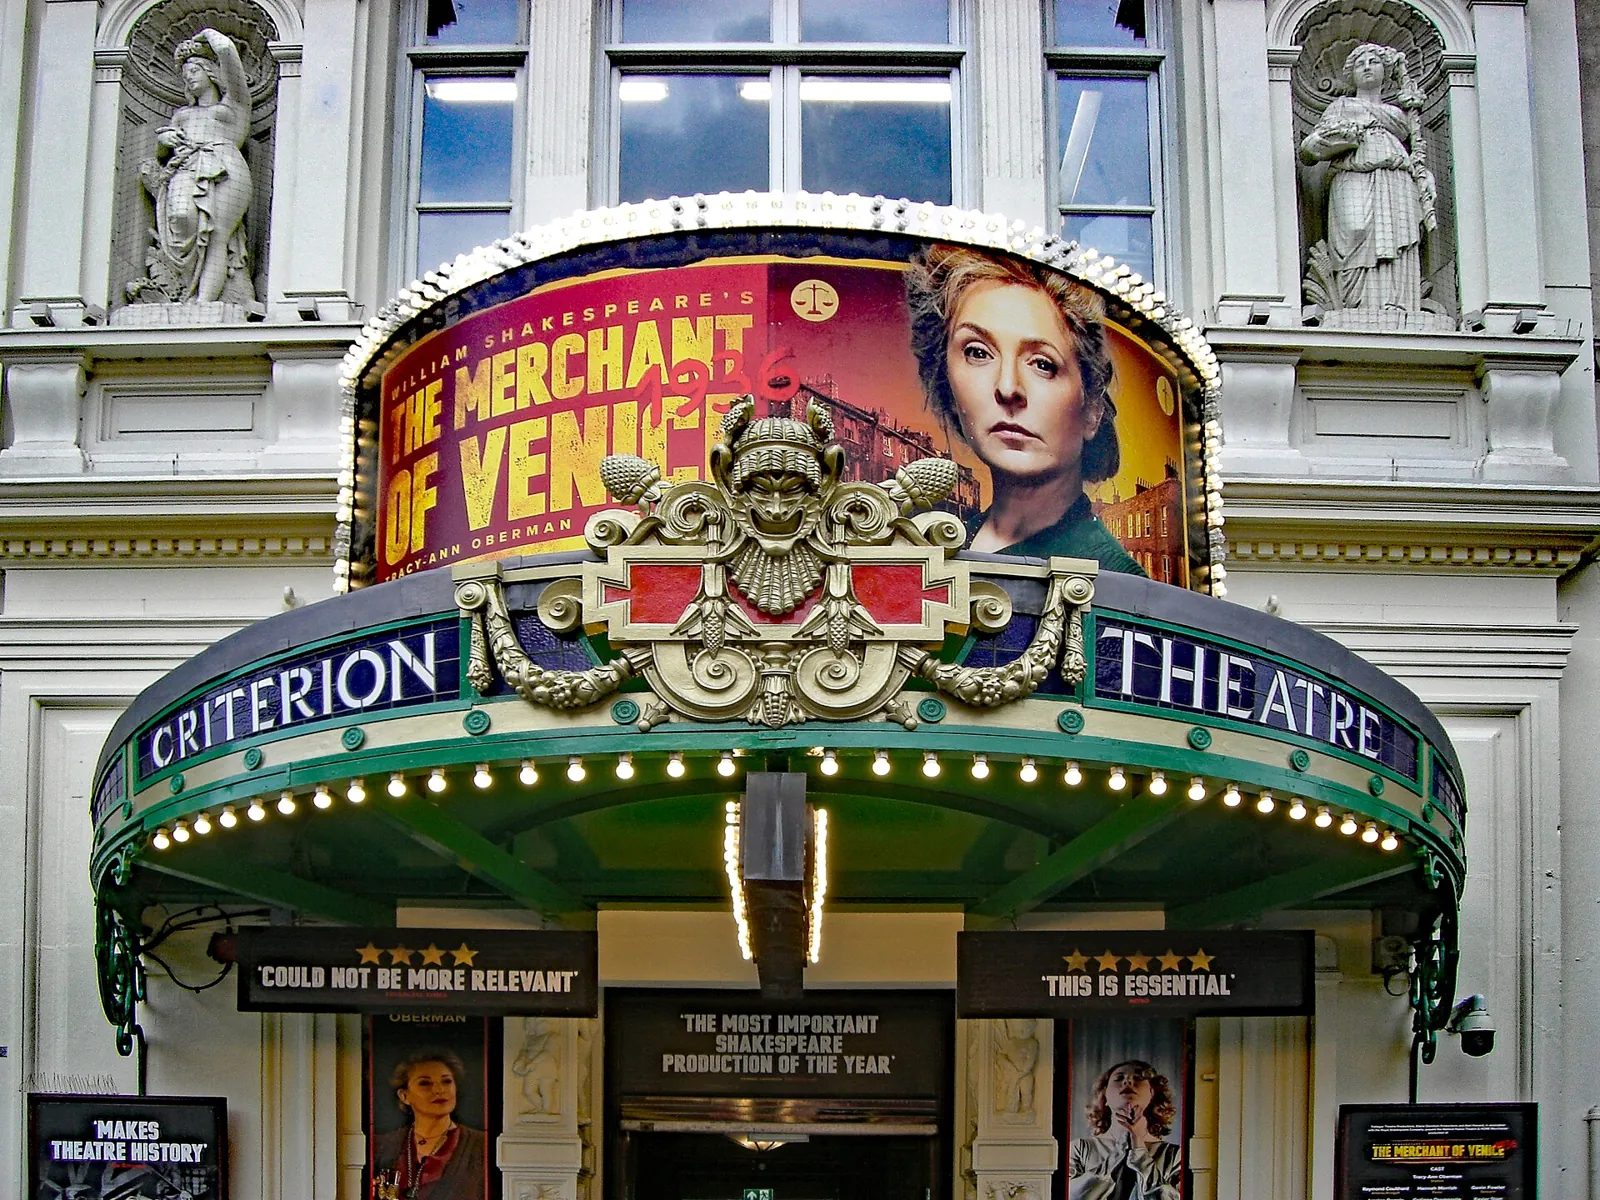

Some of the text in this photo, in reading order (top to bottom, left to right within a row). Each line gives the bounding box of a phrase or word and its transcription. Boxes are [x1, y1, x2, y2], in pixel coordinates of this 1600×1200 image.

[391, 290, 755, 399] WILLIAM SHAKESPEARE'S
[391, 314, 753, 464] THE MERCHANT
[634, 344, 802, 428] 1936
[385, 452, 438, 565] OF
[471, 518, 572, 550] OBERMAN
[151, 632, 436, 769] CRITERION
[1101, 627, 1382, 759] THEATRE
[332, 967, 371, 989] NOT
[377, 969, 402, 990] BE
[407, 969, 466, 991] MORE
[1098, 976, 1119, 997] IS
[722, 1014, 773, 1034] MOST
[777, 1014, 879, 1034] IMPORTANT
[715, 1034, 844, 1054] SHAKESPEARE
[662, 1054, 773, 1075] PRODUCTION
[778, 1055, 800, 1075] OF
[805, 1056, 838, 1075] THE
[50, 1140, 126, 1161] THEATRE
[1372, 1145, 1505, 1157] THE MERCHANT OF VENICE
